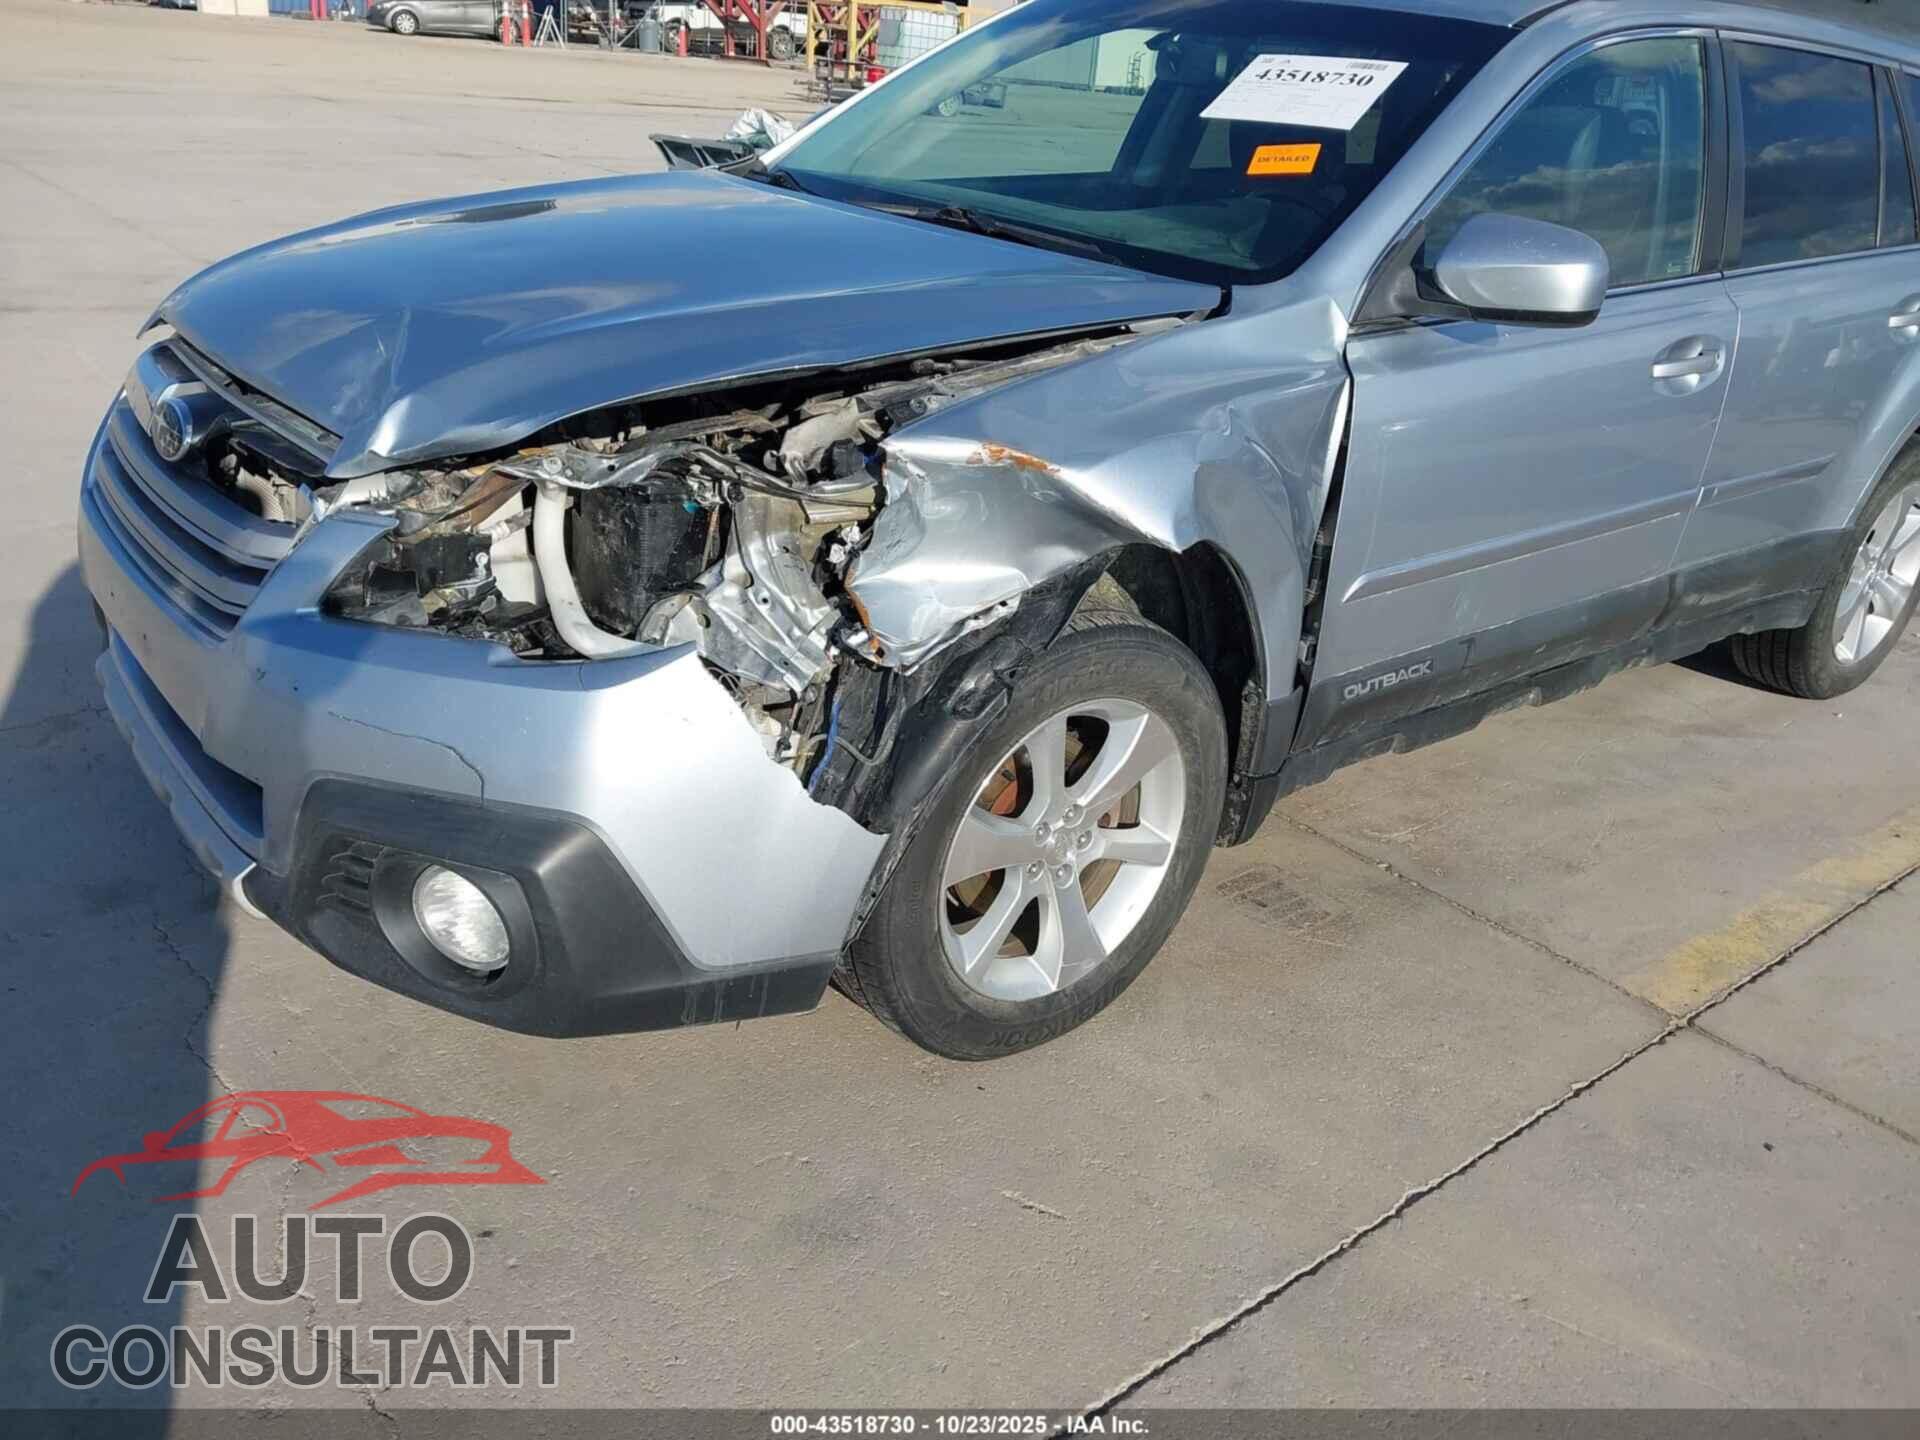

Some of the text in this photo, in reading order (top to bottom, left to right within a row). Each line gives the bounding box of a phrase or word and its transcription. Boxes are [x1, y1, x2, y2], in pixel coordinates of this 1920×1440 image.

[1256, 67, 1374, 87] 43518730
[1257, 155, 1311, 164] DETAILED
[1344, 660, 1432, 700] OUTBACK
